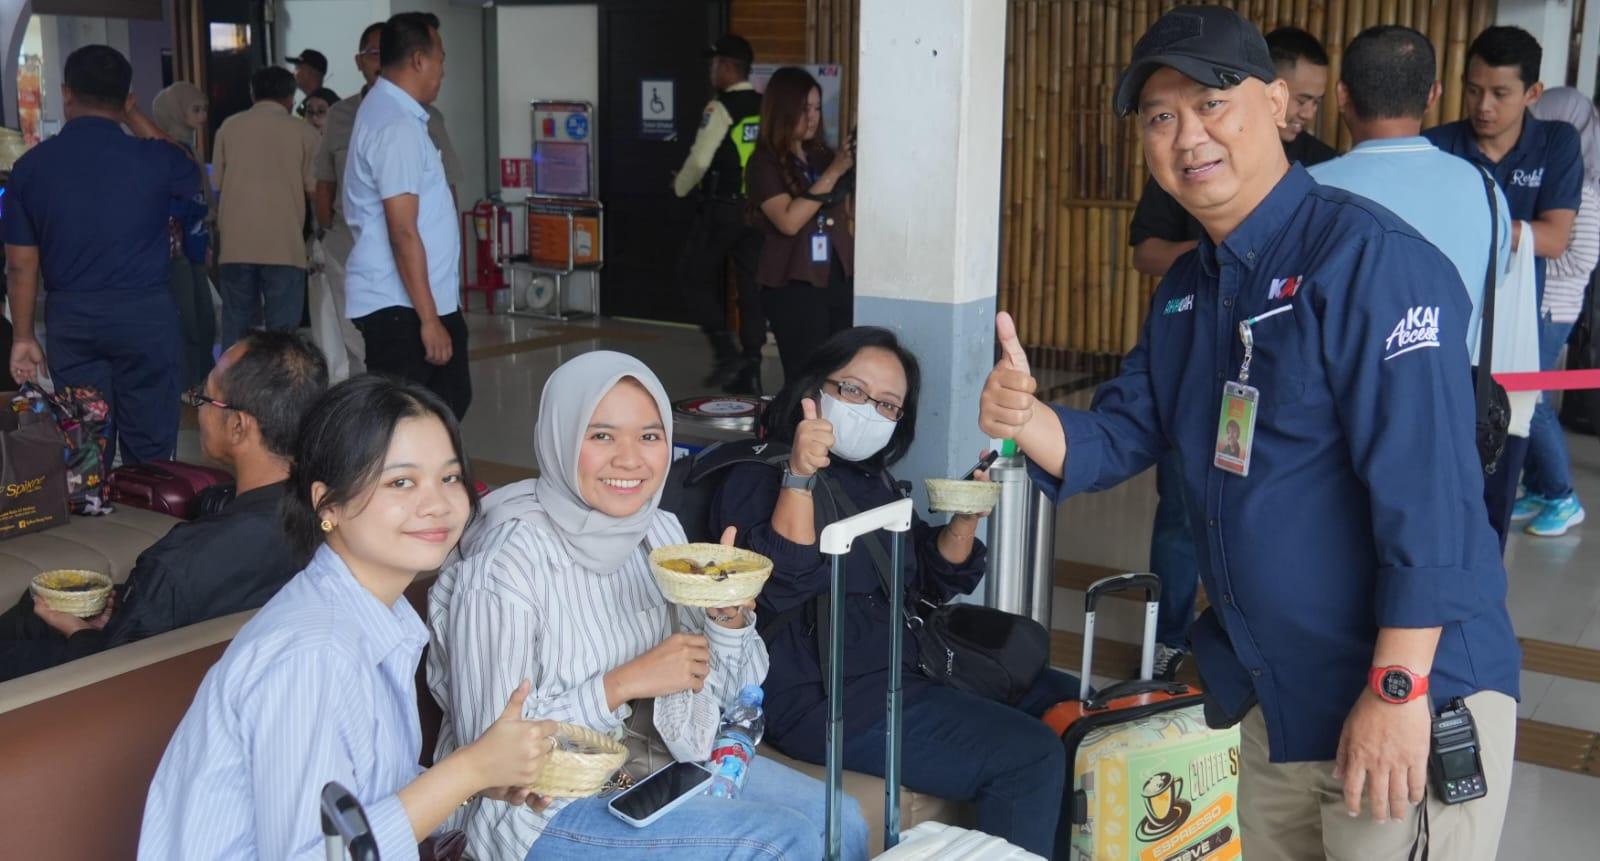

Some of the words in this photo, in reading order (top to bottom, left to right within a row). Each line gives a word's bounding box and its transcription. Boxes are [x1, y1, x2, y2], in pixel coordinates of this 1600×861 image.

[1268, 275, 1303, 300] KAI
[1406, 306, 1439, 330] KAI
[1386, 318, 1440, 350] Access
